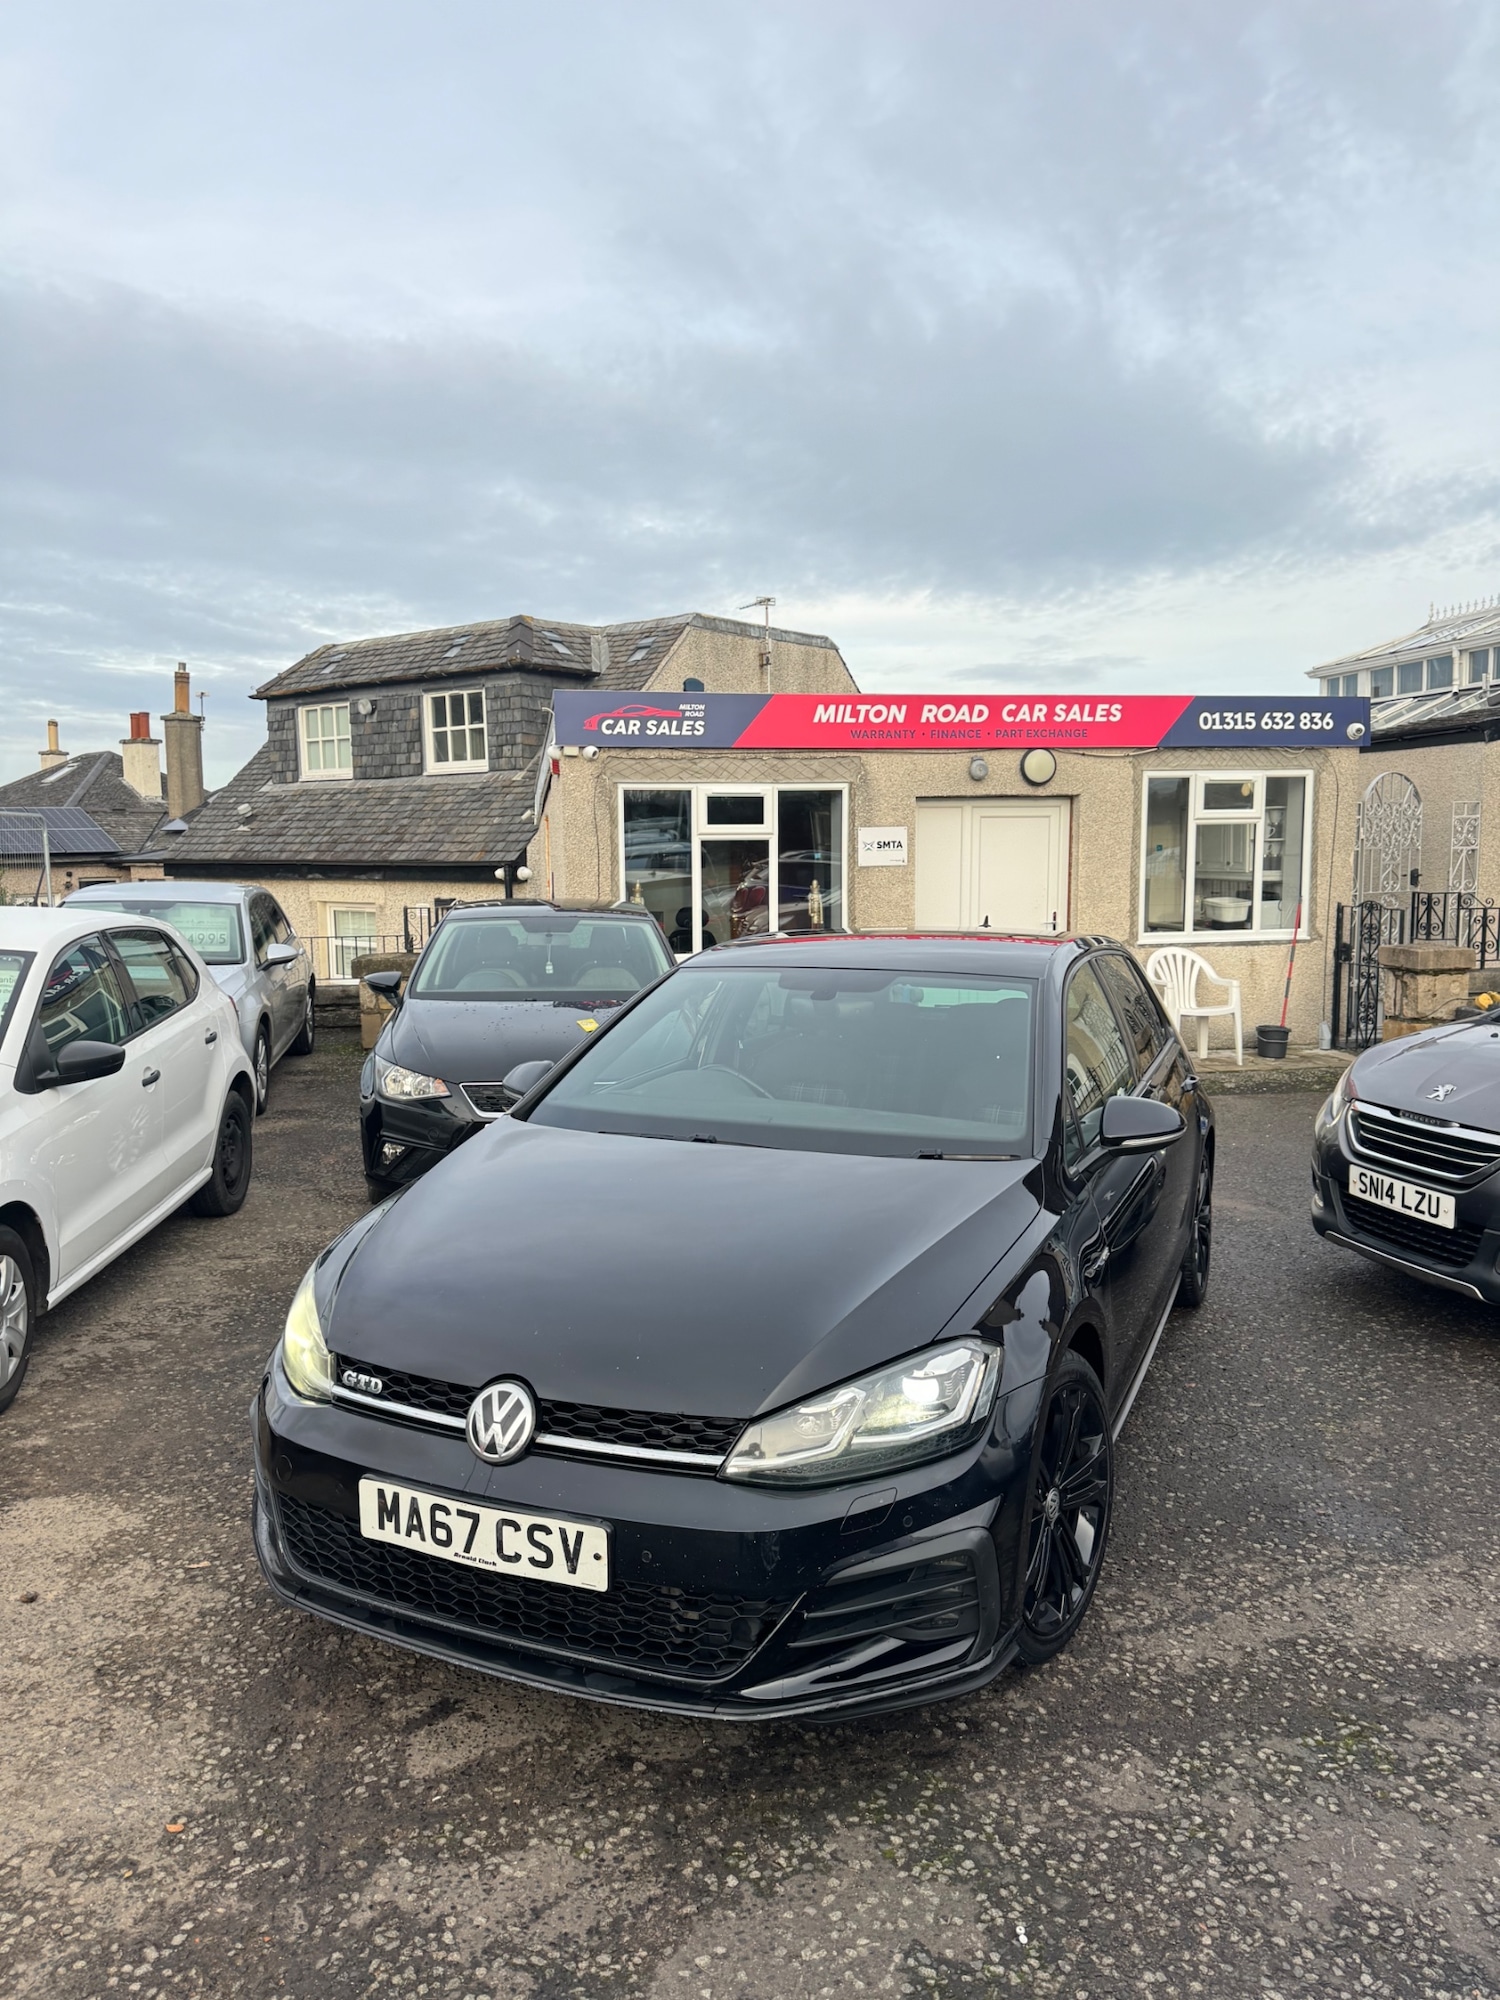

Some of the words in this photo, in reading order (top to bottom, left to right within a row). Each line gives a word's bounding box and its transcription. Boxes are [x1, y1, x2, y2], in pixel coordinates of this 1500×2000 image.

[679, 703, 706, 711] MILTON
[684, 710, 705, 718] ROAD
[812, 703, 907, 724] MILTON
[920, 703, 990, 723] ROAD
[1001, 703, 1048, 723] CAR
[1053, 703, 1123, 723] SALES
[601, 719, 641, 736] CAR
[645, 719, 706, 736] SALES
[1198, 711, 1257, 731] 01315
[1260, 711, 1295, 731] 632
[1299, 711, 1334, 731] 836
[850, 729, 916, 739] WARRANTY
[930, 729, 982, 739] FINANCE
[995, 728, 1023, 738] PART
[1026, 728, 1088, 738] EXCHANGE
[876, 840, 903, 849] SMTA
[1358, 1172, 1396, 1205] SN14
[1401, 1185, 1440, 1219] LZU
[342, 1370, 383, 1395] GTD
[376, 1487, 480, 1554] MA67
[495, 1517, 584, 1576] CSV
